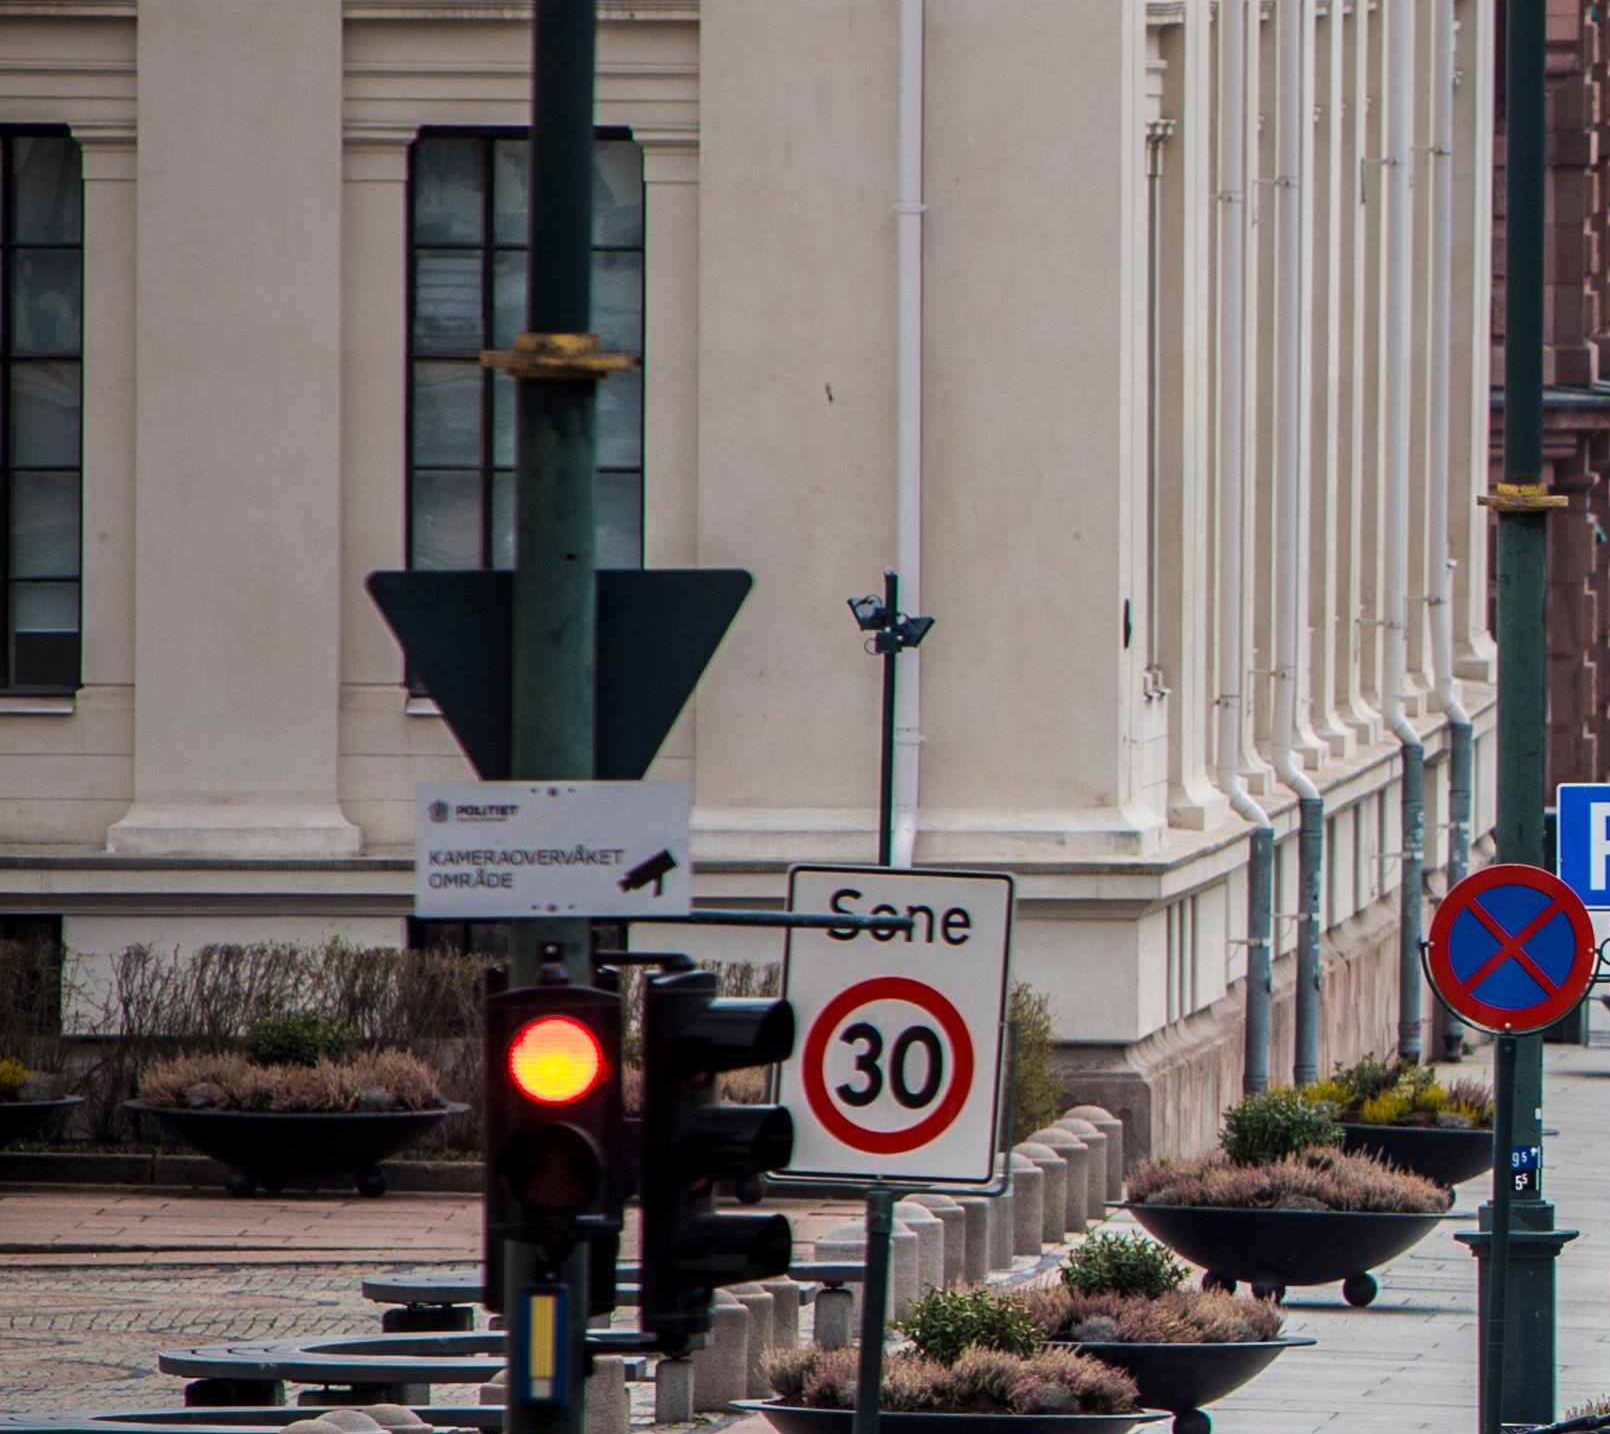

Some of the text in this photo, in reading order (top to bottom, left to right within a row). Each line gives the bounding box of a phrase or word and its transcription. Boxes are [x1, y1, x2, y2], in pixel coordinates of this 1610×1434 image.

[455, 804, 518, 816] POLITIET
[427, 844, 624, 866] KAMERAOVERVÅKET
[428, 868, 514, 889] OMRÅDE
[826, 888, 972, 946] Sone
[835, 1021, 943, 1110] 30
